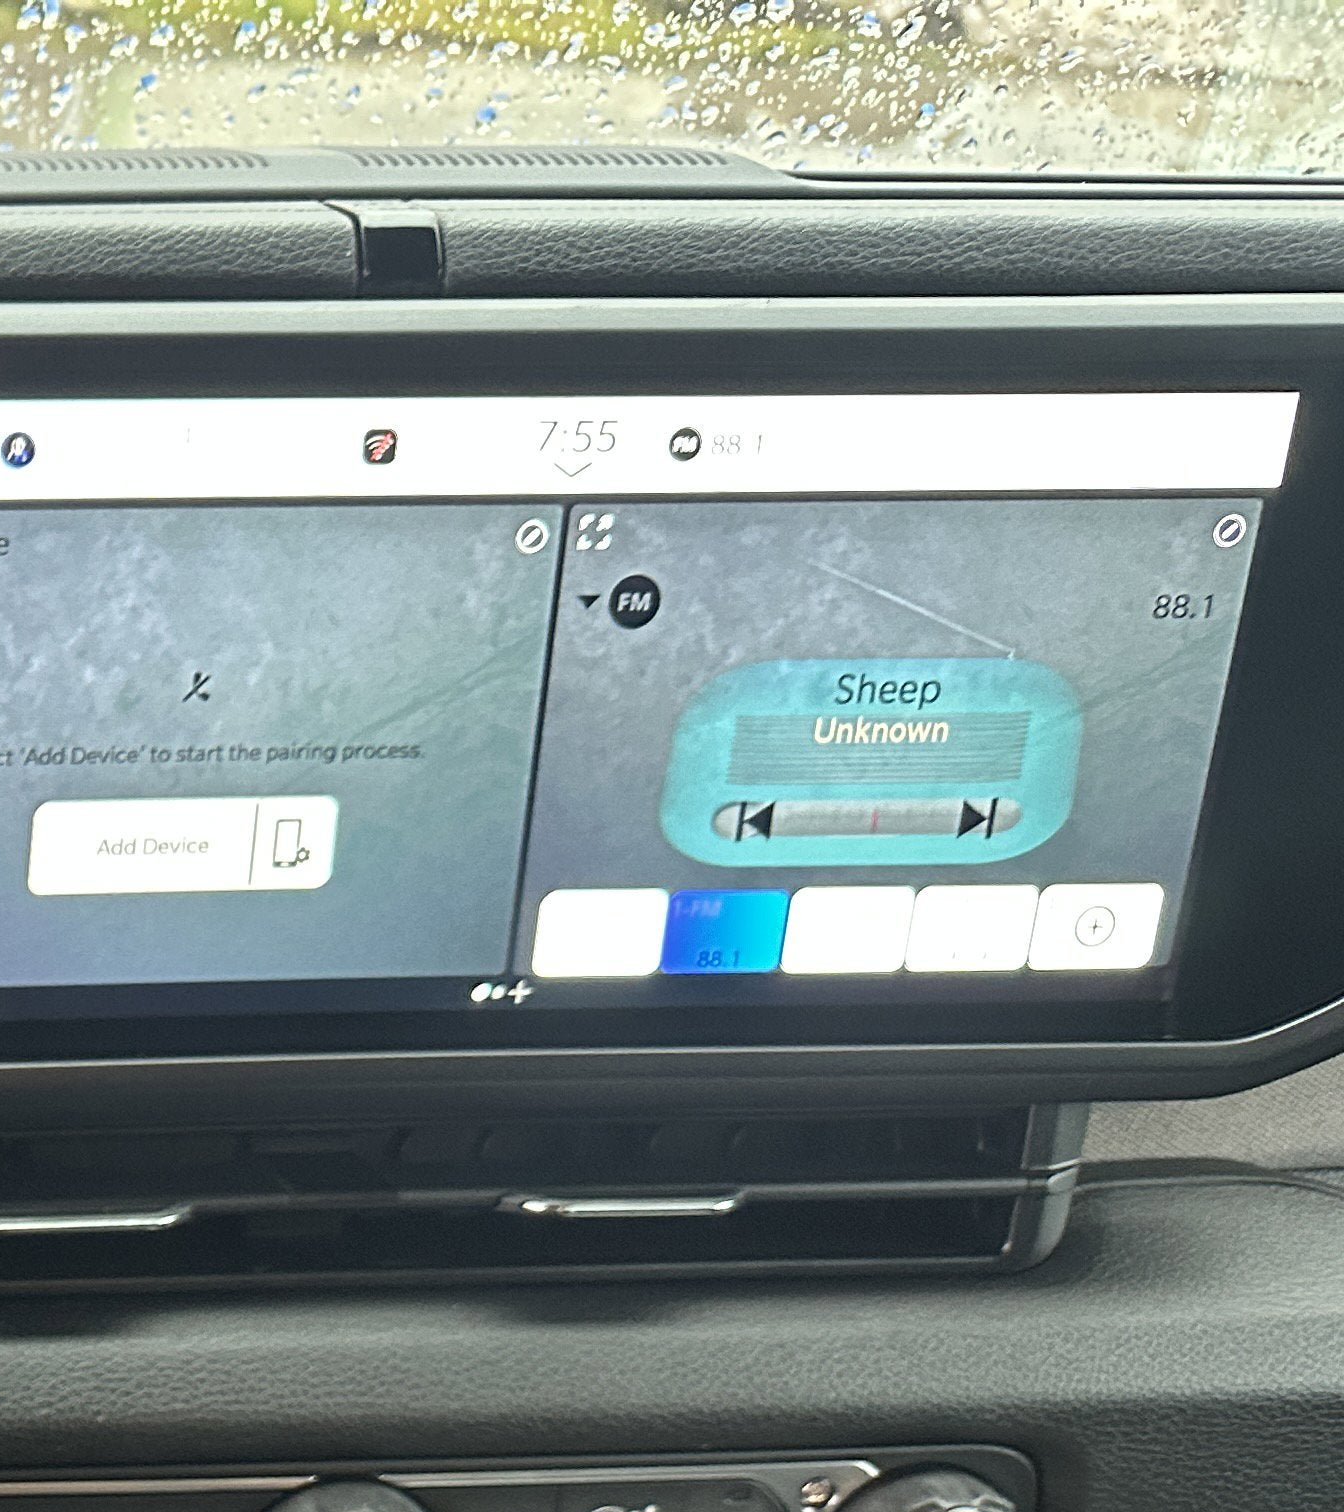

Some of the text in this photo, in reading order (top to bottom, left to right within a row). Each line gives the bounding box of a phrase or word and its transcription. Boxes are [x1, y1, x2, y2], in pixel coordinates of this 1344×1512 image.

[538, 420, 619, 453] 7:55
[615, 592, 654, 613] FM
[1151, 593, 1216, 621] 88.1
[833, 672, 943, 712] Sheep
[812, 715, 951, 746] Unknown
[19, 746, 65, 767] 'Add
[69, 744, 146, 766] Device'
[150, 746, 171, 764] to
[174, 743, 223, 763] start
[228, 742, 263, 762] the
[265, 741, 338, 766] pairing
[96, 836, 211, 857] Add Device
